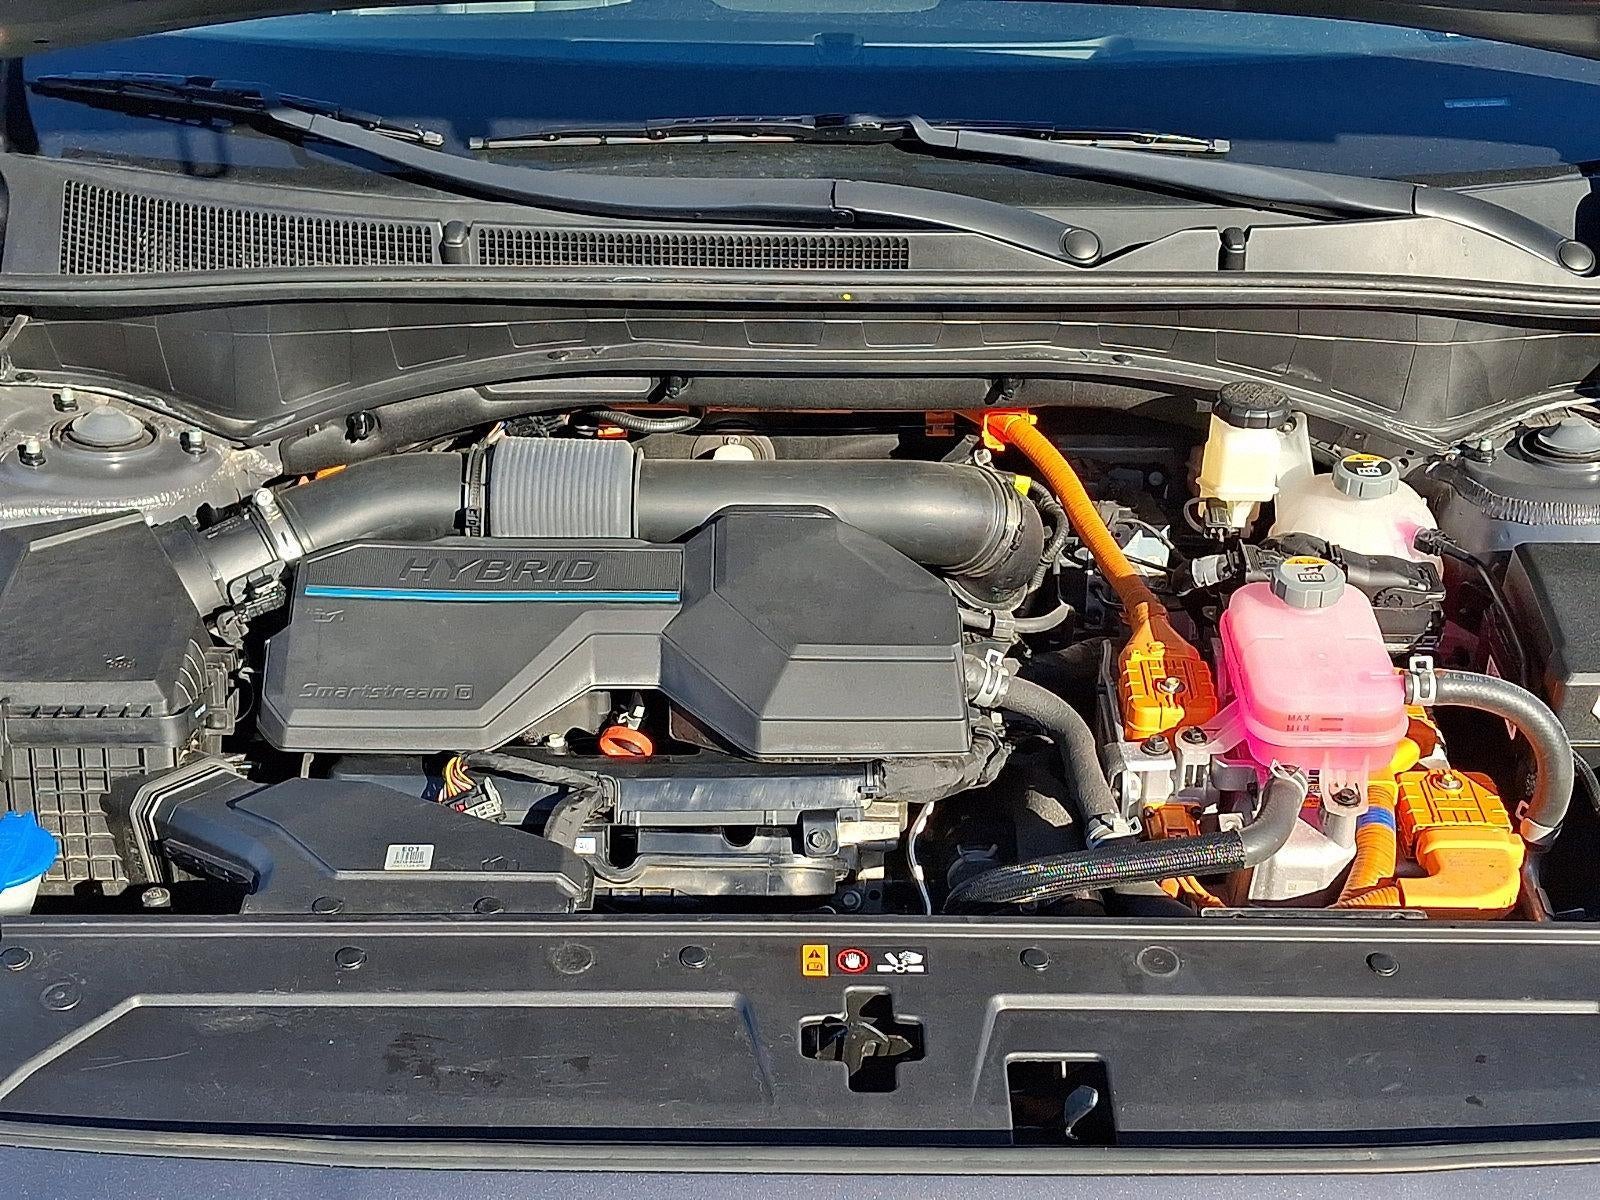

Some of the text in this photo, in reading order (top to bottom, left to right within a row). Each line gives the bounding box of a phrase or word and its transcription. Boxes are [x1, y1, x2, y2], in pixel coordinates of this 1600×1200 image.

[398, 557, 601, 583] HYBRID
[299, 682, 449, 699] Smartstream
[1287, 714, 1310, 722] MAX
